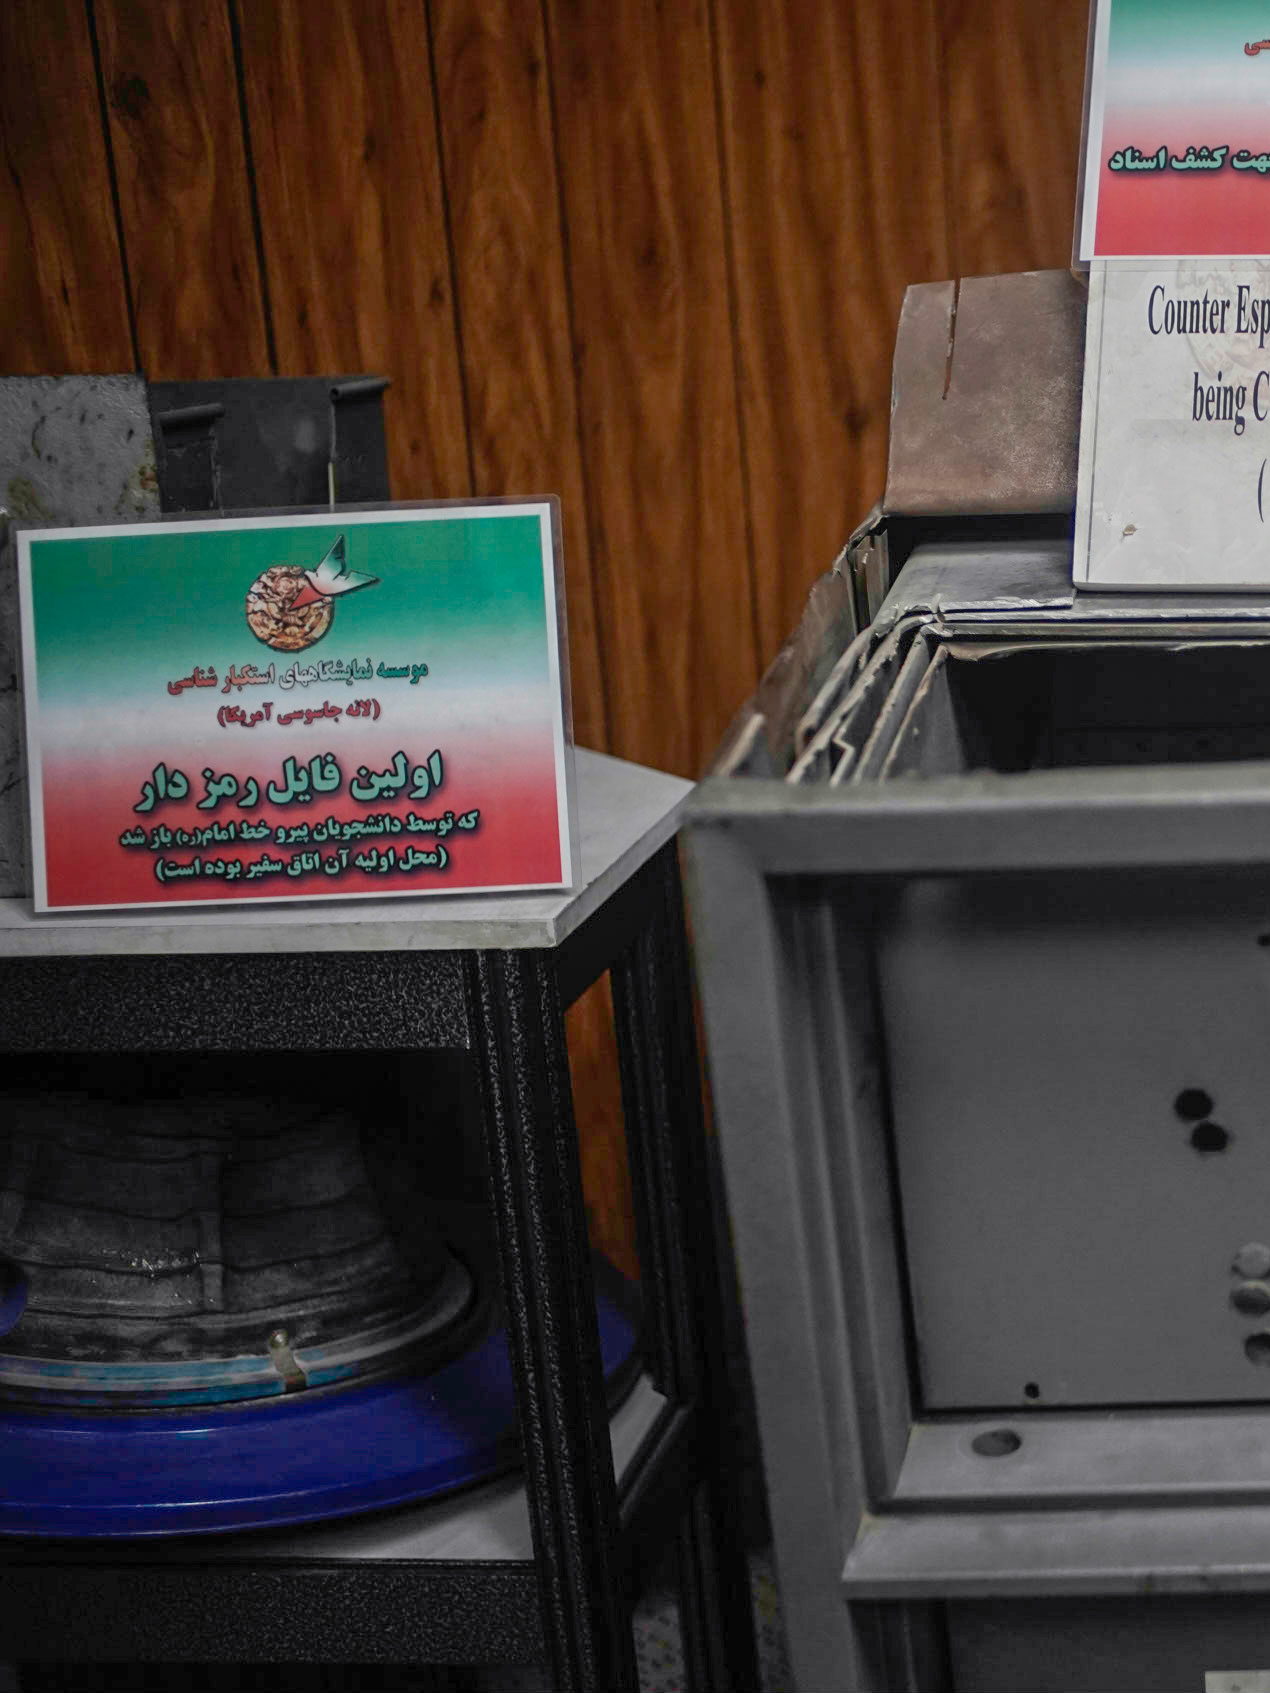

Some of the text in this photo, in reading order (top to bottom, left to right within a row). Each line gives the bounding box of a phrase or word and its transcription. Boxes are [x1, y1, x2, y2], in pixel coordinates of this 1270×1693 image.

[1108, 145, 1168, 171] اسناد
[1170, 145, 1229, 170] کشف
[1148, 285, 1230, 336] Counter
[1192, 370, 1247, 436] being
[168, 666, 218, 695] شناسی
[222, 663, 275, 693] استکبار
[376, 661, 428, 684] موسسه
[277, 702, 342, 724] جاسوسی
[133, 749, 443, 812] اولین فایل رمز دار
[239, 819, 271, 840] خط
[312, 814, 402, 841] دانشجویان
[406, 811, 454, 836] توسط
[457, 809, 480, 830] که
[120, 825, 147, 847] شد
[150, 823, 172, 849] باز
[274, 825, 308, 843] پیرو
[204, 858, 242, 879] بوده
[245, 854, 283, 878] سفیر
[287, 851, 320, 876] اتاق
[324, 849, 350, 874] آن
[354, 846, 395, 872] اولیه
